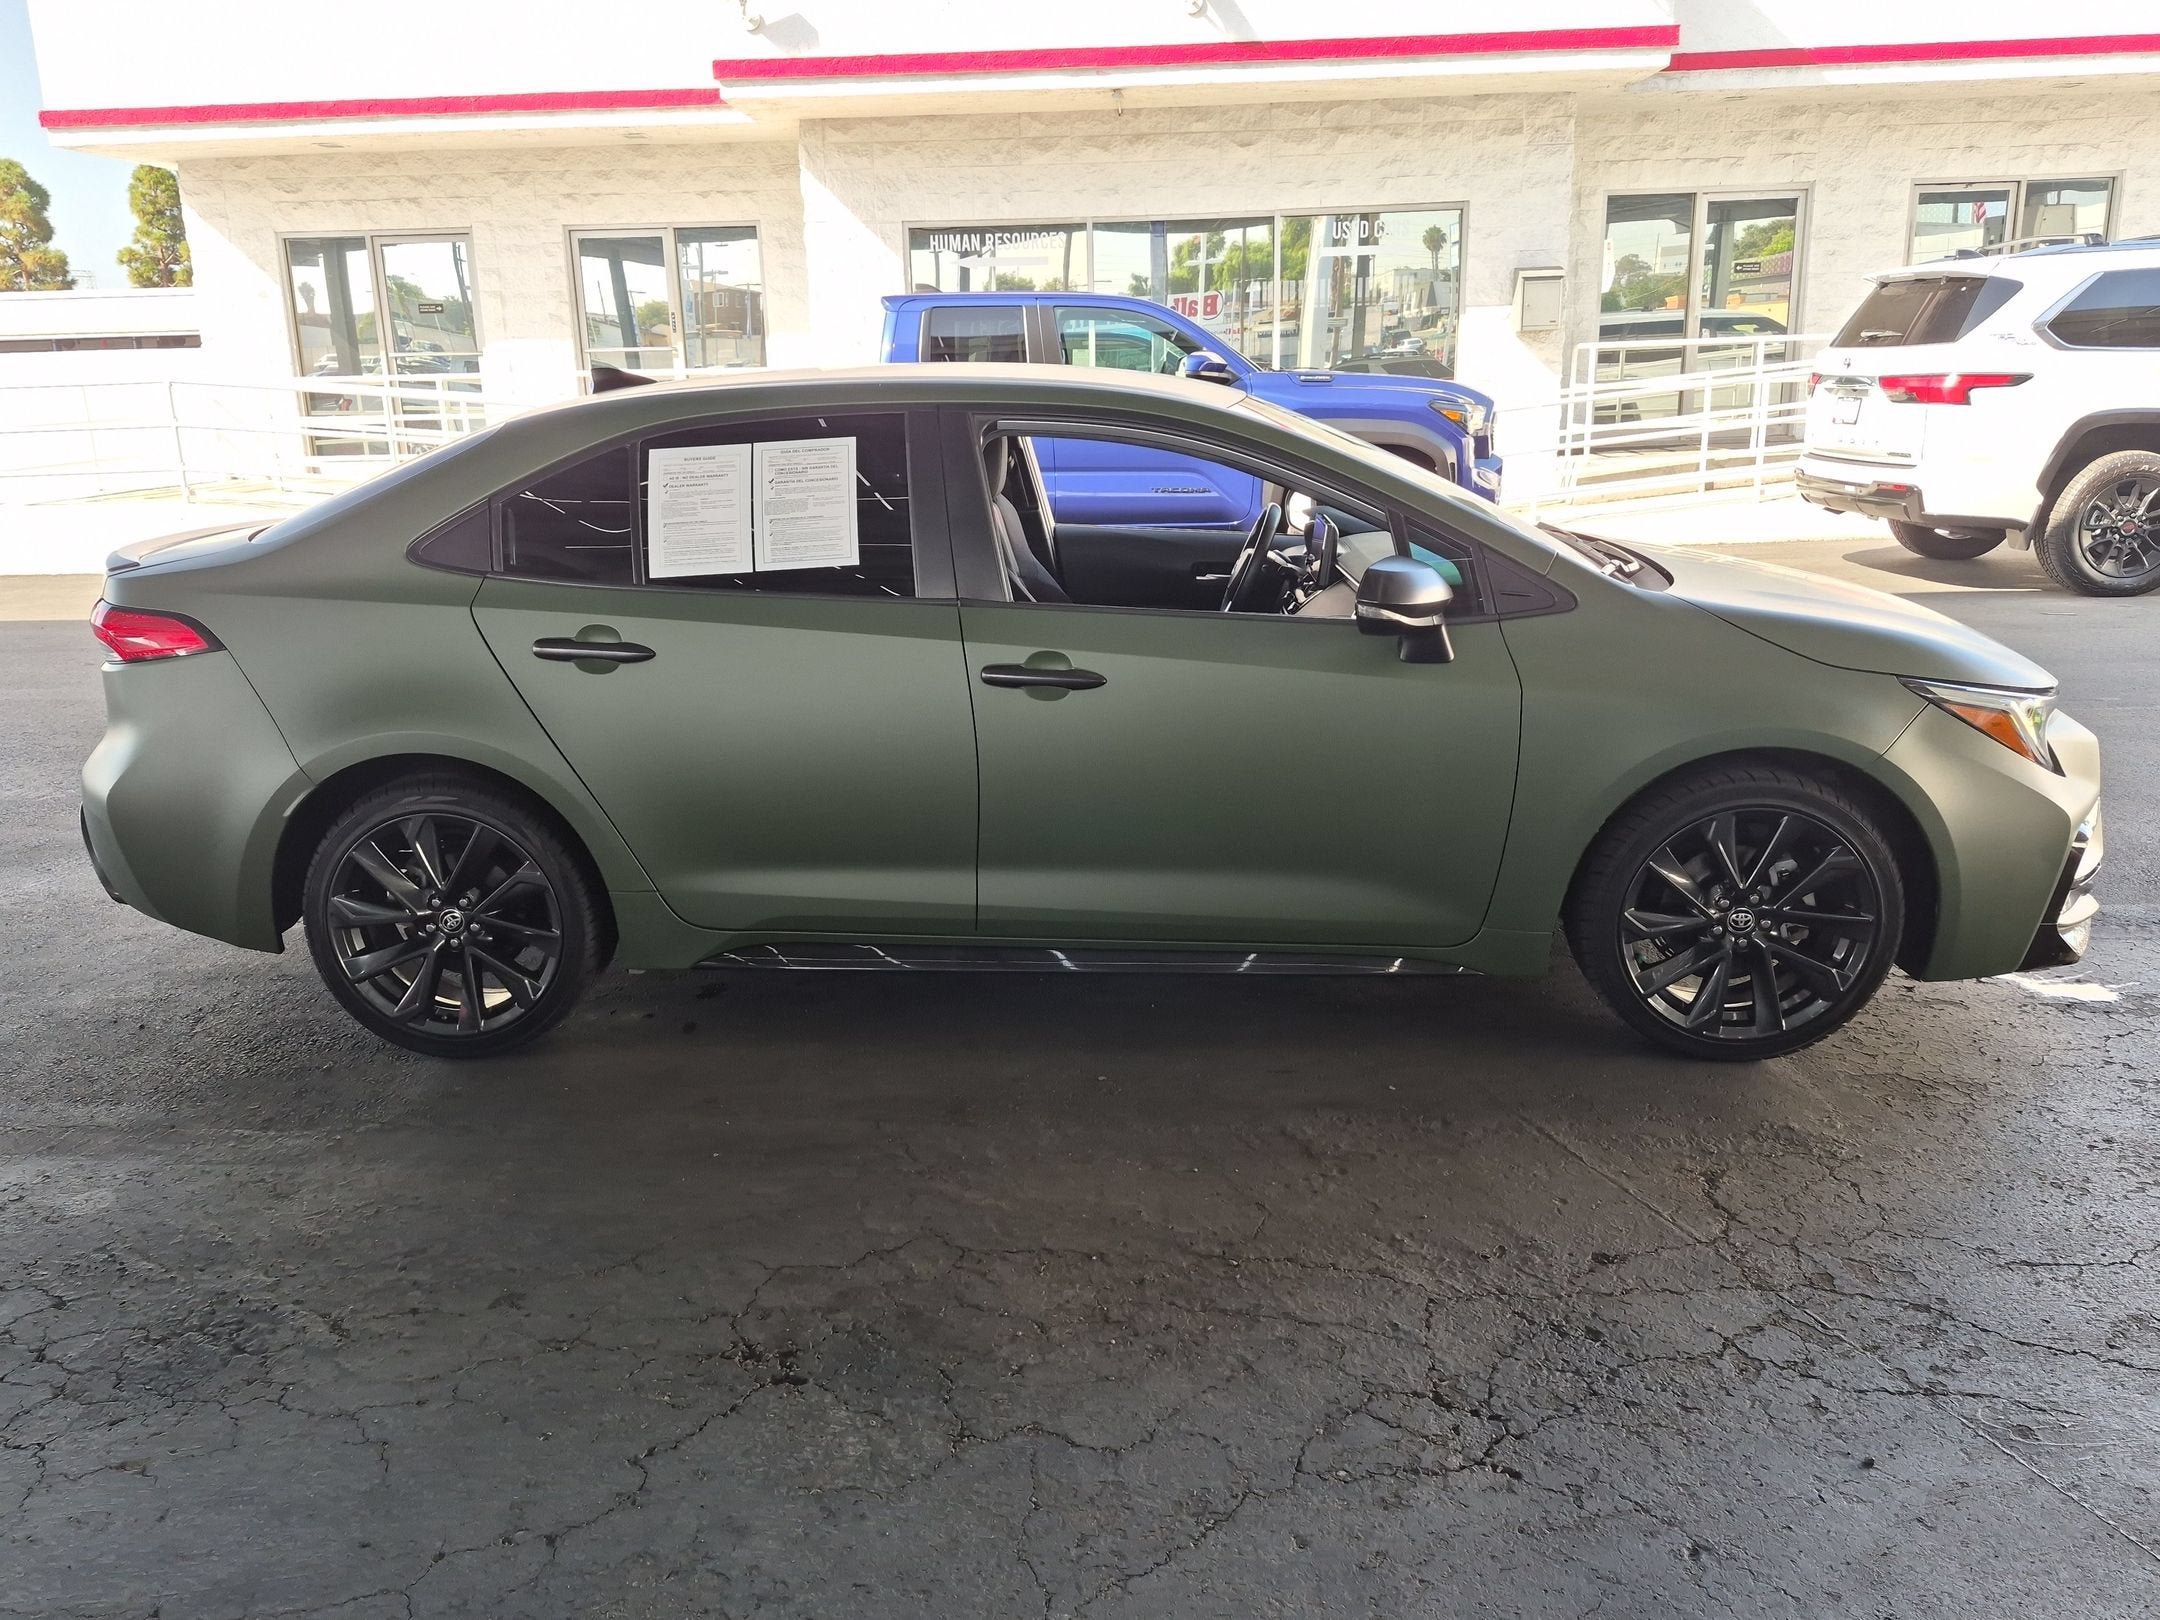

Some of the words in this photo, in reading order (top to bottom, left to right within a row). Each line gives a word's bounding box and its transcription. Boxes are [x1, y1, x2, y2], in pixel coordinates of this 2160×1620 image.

[1332, 220, 1369, 239] USD
[929, 233, 981, 251] HUMAN
[984, 231, 1066, 250] RESOURCES
